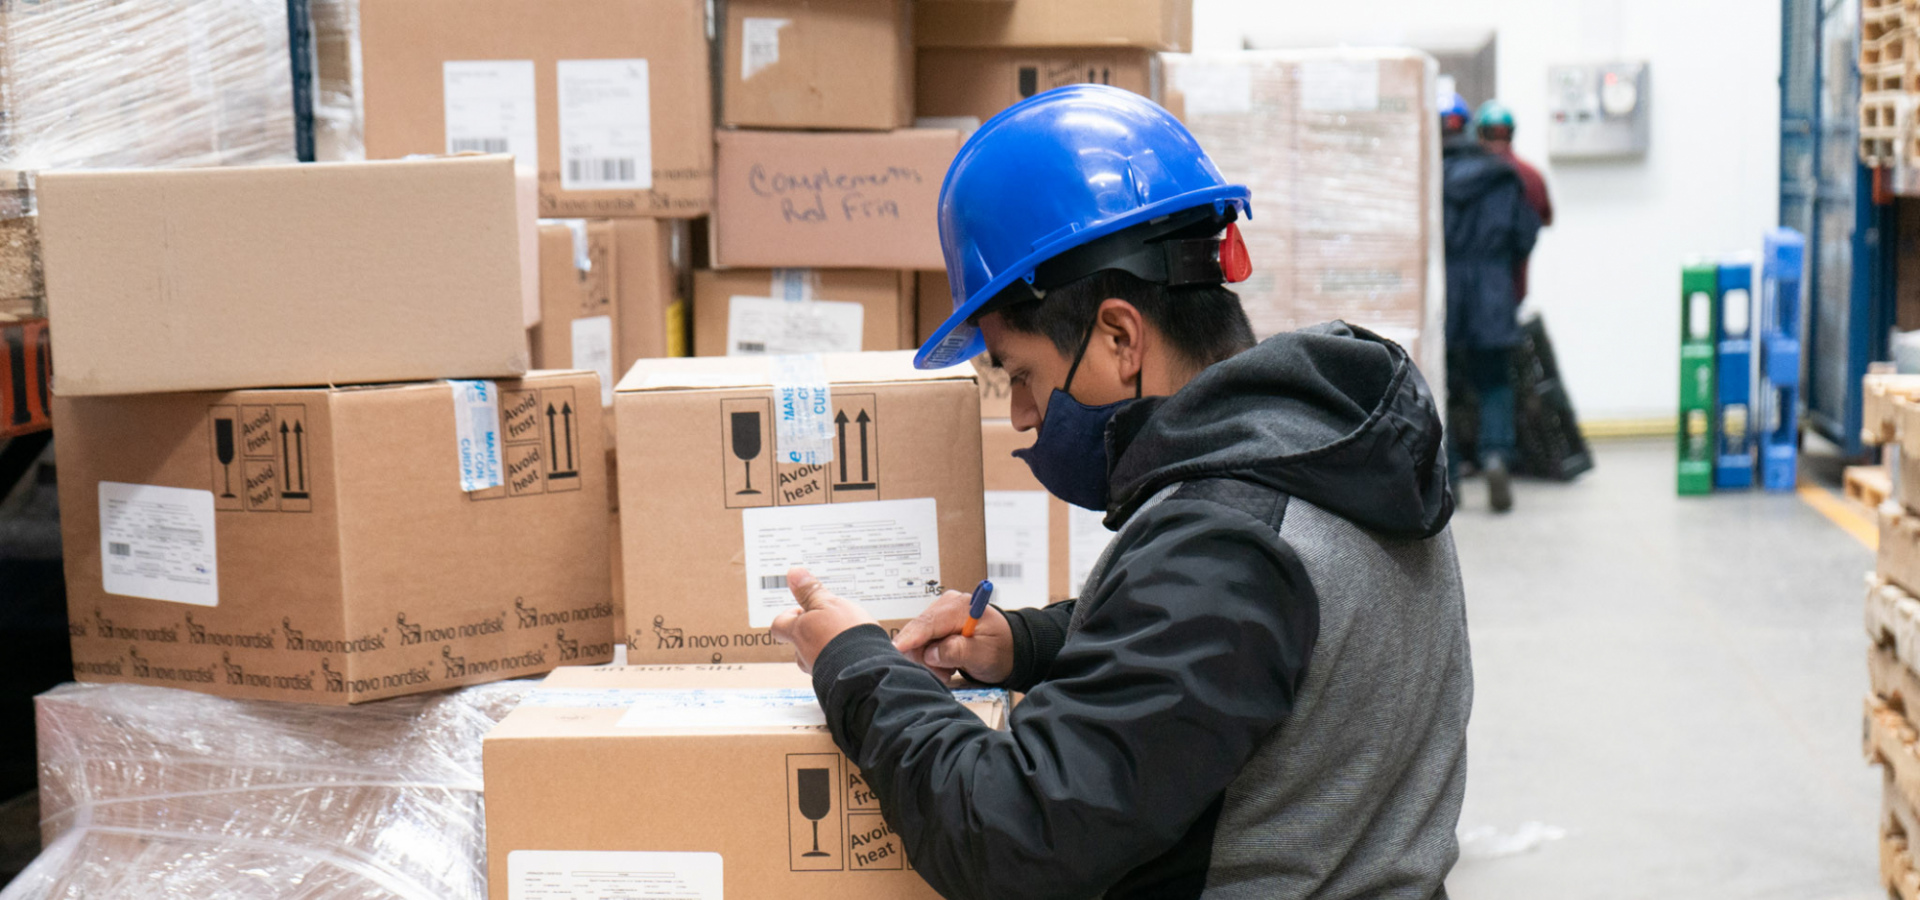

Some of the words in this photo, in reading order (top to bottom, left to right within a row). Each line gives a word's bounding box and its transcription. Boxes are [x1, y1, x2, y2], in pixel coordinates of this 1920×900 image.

[504, 393, 537, 423] Avoid
[242, 408, 271, 436] Avoid
[508, 414, 536, 438] frost
[246, 430, 271, 453] frost
[474, 452, 485, 479] CON
[508, 447, 541, 478] Avoid
[246, 463, 275, 491] Avoid
[511, 469, 540, 493] heat
[249, 486, 274, 508] heat
[783, 479, 821, 503] heat
[540, 611, 570, 627] novo
[114, 626, 139, 639] novo
[205, 632, 233, 646] novo
[424, 625, 456, 642] novo
[689, 634, 729, 649] novo
[307, 638, 333, 652] novo
[580, 641, 608, 658] novo
[149, 664, 175, 678] novo
[467, 659, 498, 675] novo
[245, 673, 271, 688] novo
[345, 677, 380, 693] novo
[855, 841, 896, 867] heat
